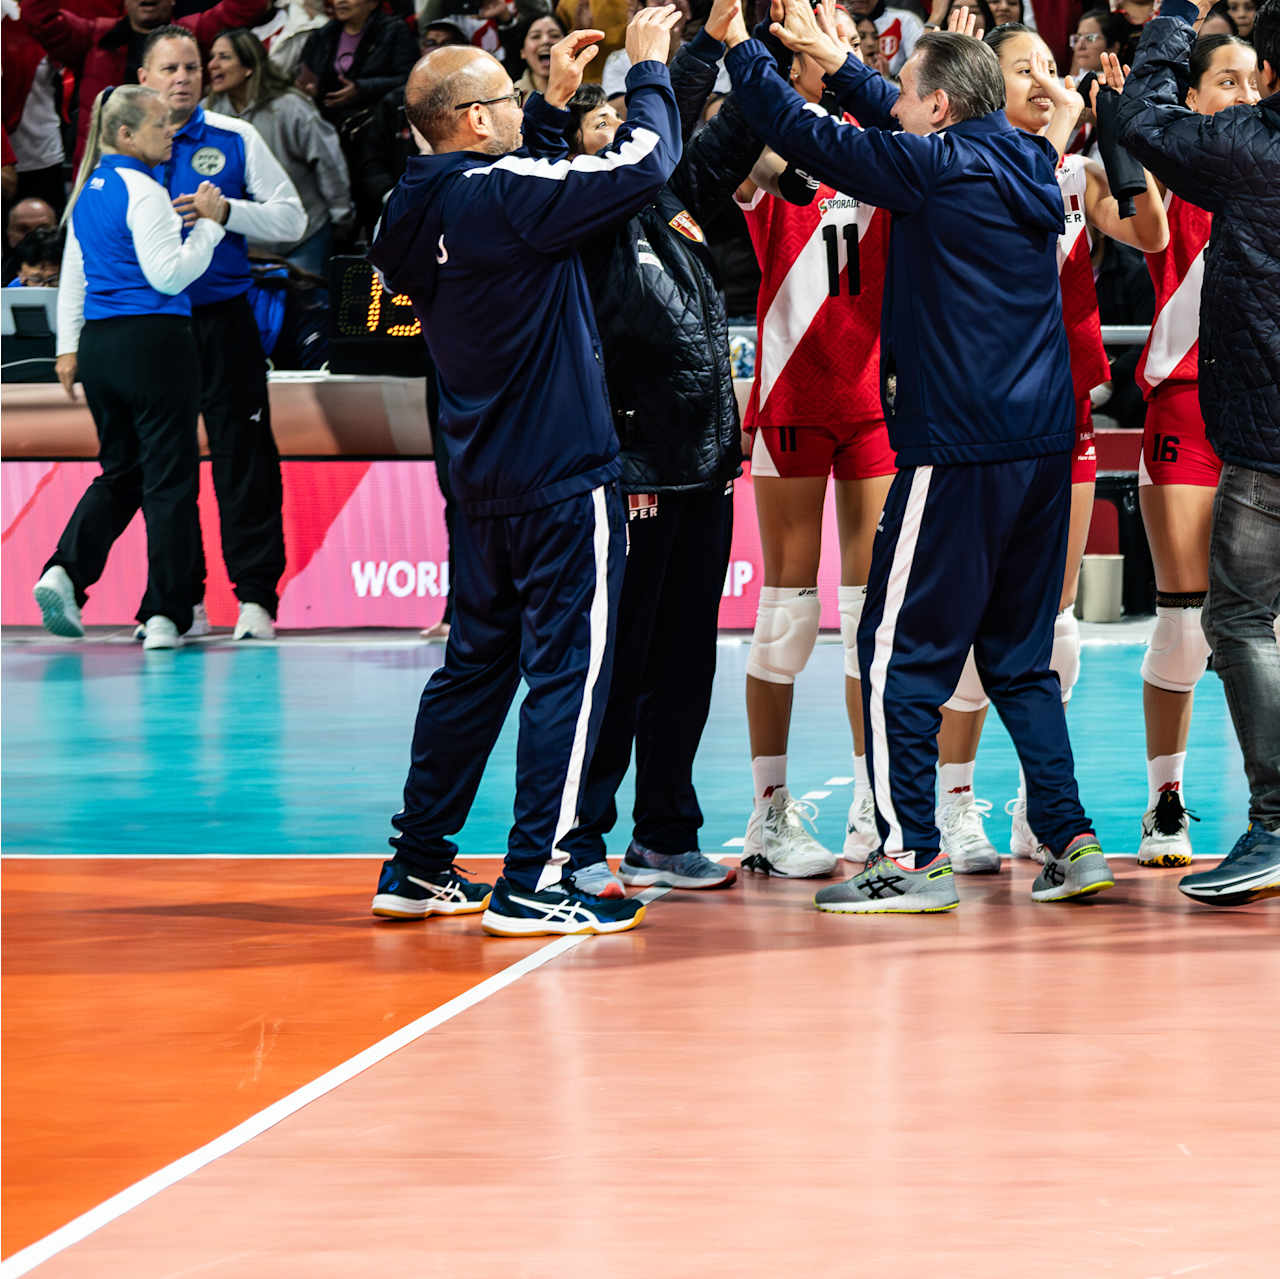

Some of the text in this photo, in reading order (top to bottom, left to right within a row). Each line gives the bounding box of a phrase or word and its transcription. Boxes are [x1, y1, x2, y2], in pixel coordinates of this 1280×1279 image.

[1064, 213, 1083, 225] ER
[822, 223, 861, 298] 11
[778, 426, 798, 452] 11
[1152, 433, 1181, 463] 16
[630, 507, 659, 521] PER
